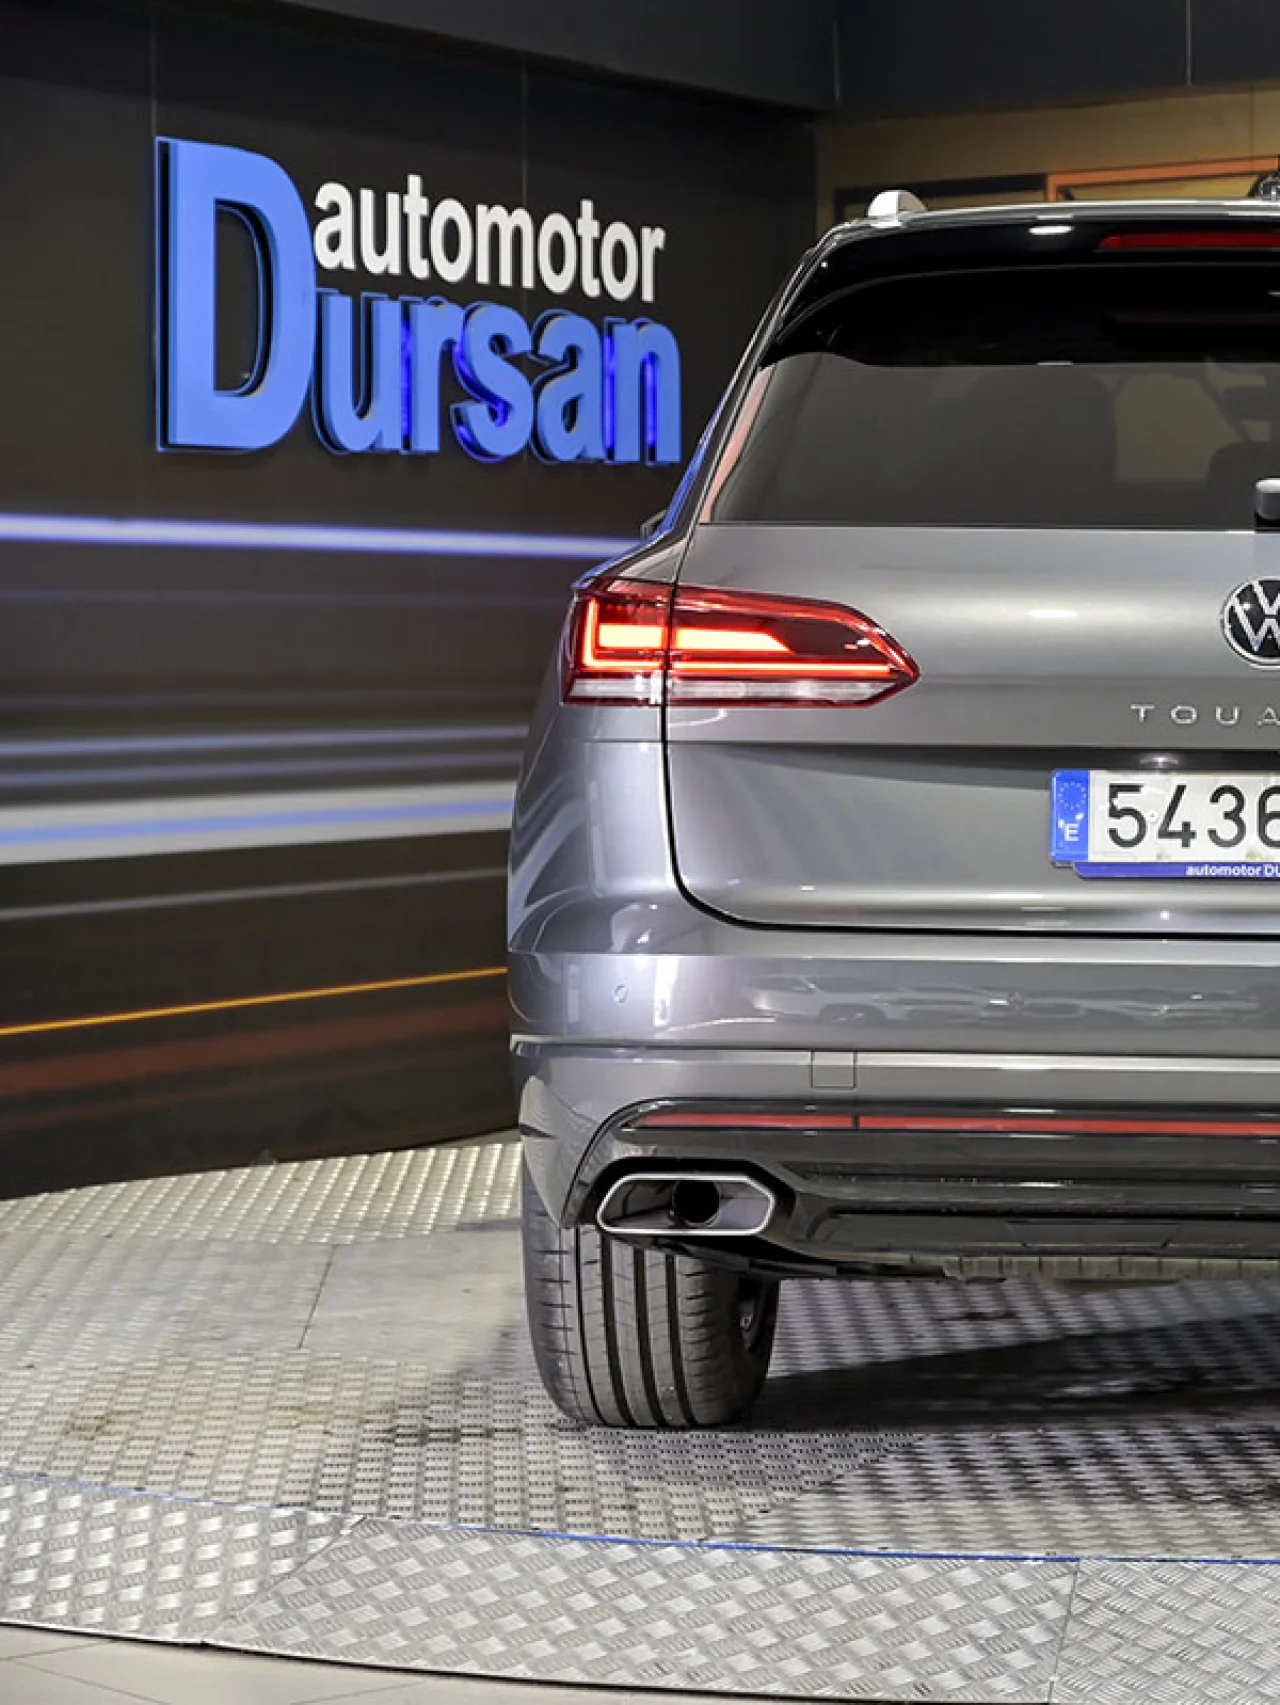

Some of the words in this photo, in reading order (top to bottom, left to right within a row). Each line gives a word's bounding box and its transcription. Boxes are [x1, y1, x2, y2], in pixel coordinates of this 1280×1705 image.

[156, 136, 682, 465] Dursan
[313, 174, 665, 302] automotor
[1064, 823, 1079, 841] E
